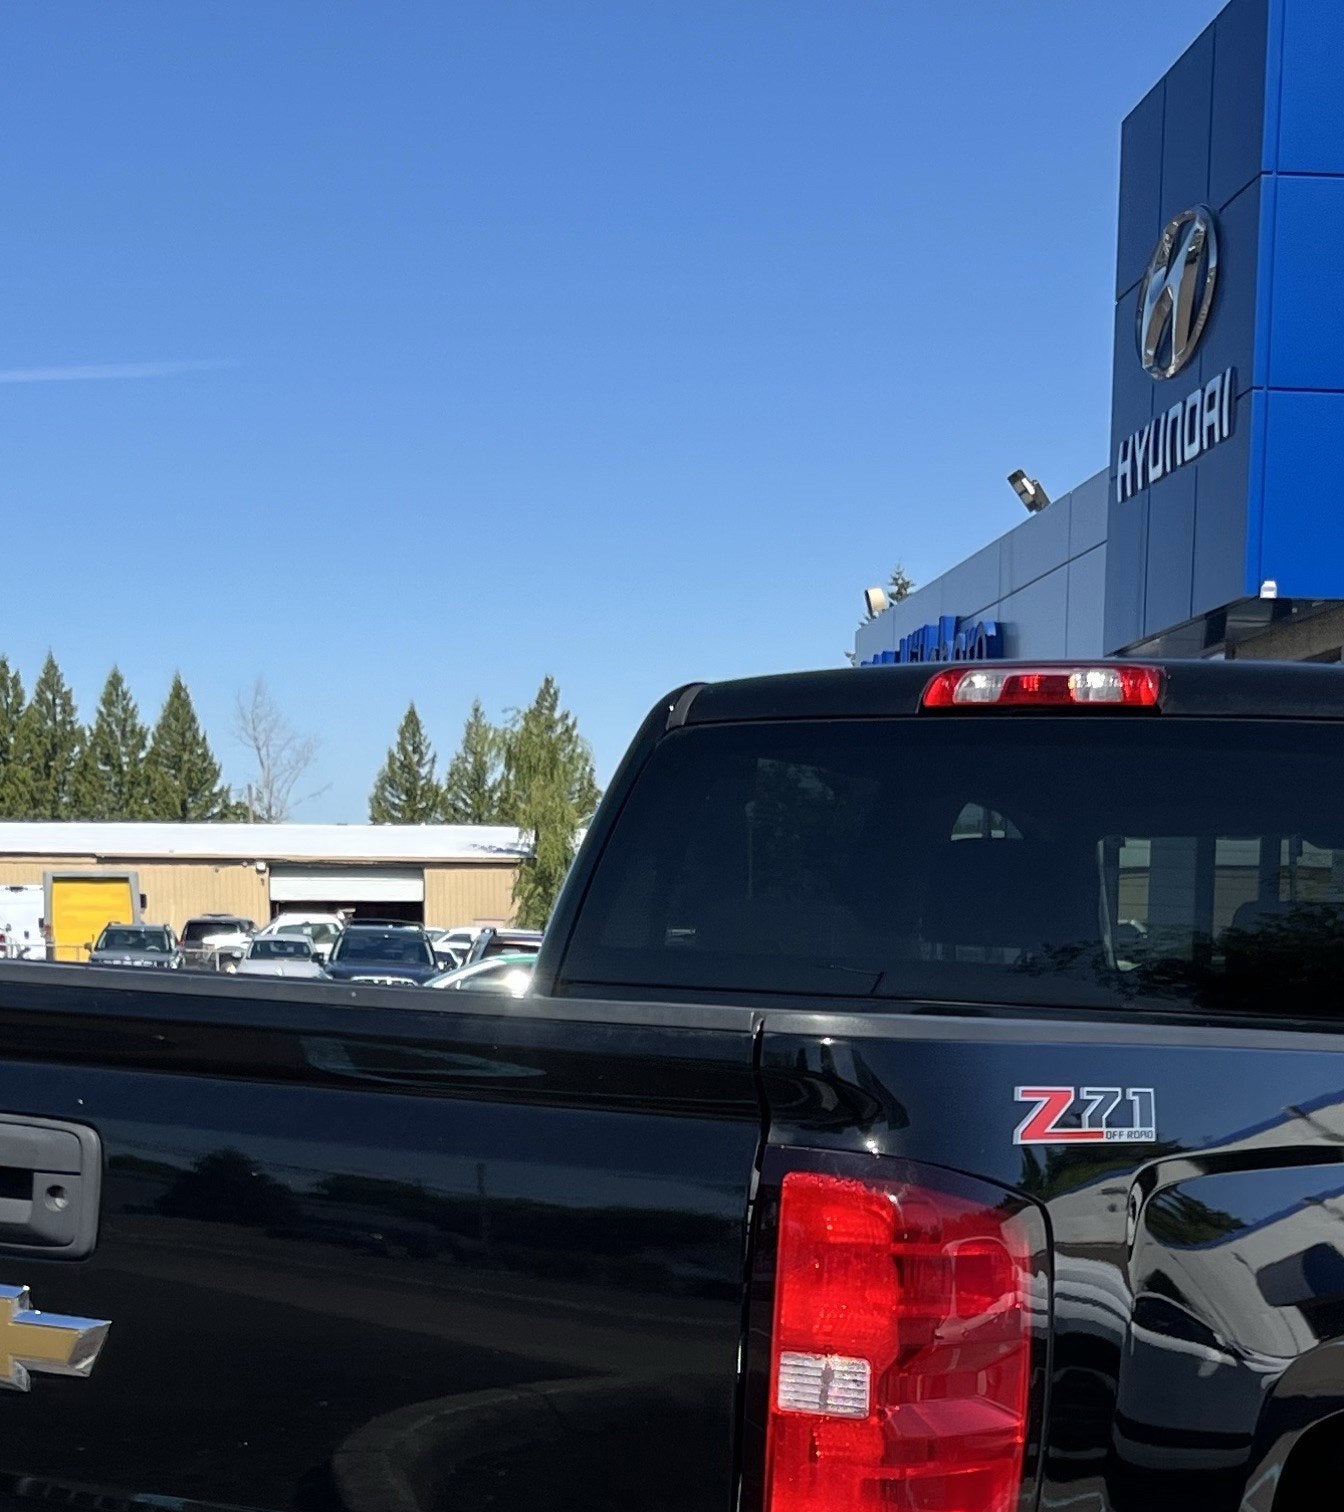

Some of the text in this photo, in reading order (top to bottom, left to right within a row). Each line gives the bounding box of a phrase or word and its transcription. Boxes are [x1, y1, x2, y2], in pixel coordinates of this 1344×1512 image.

[1117, 366, 1233, 503] HYUNDAI
[1013, 1086, 1156, 1144] Z71
[1106, 1130, 1154, 1140] OFF ROAD
